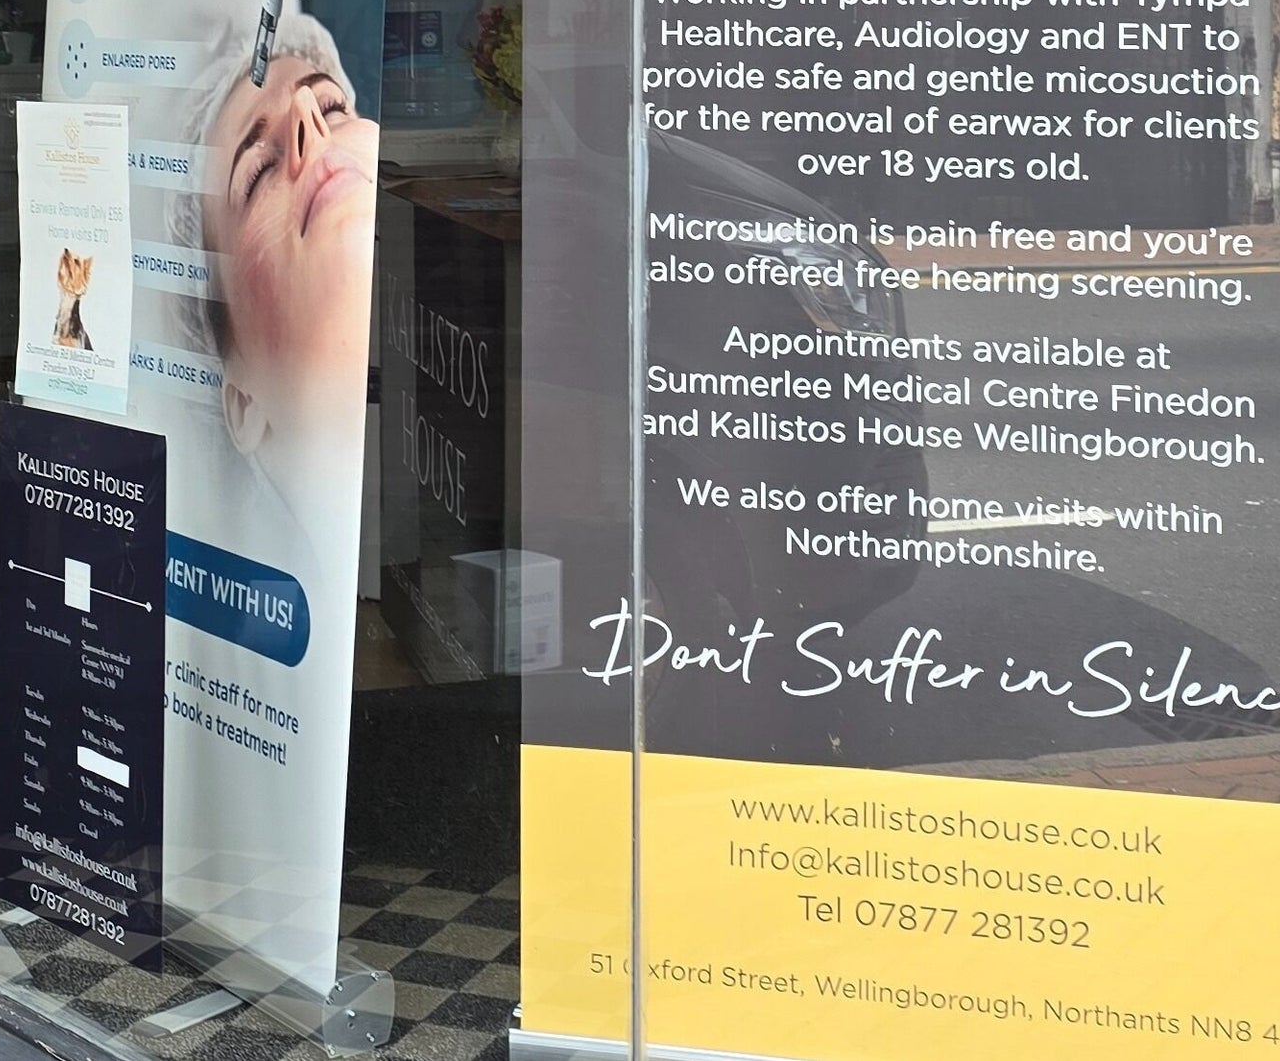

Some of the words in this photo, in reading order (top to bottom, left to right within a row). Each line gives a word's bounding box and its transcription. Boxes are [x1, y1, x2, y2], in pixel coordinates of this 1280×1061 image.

[103, 54, 146, 68] ENLARGED
[148, 56, 176, 70] PORES
[662, 19, 842, 50] Healthcare,
[855, 21, 1029, 54] Audiology
[1041, 22, 1104, 49] and
[1119, 23, 1191, 50] ENT
[1203, 25, 1239, 50] to
[643, 62, 764, 92] provide
[776, 63, 842, 89] safe
[854, 64, 914, 90] and
[927, 65, 1033, 96] gentle
[1047, 66, 1259, 95] micosuction
[646, 103, 688, 129] for
[699, 104, 750, 130] the
[762, 106, 891, 132] removal
[904, 107, 938, 133] of
[949, 114, 1071, 136] earwax
[1084, 110, 1133, 137] for
[1145, 111, 1259, 139] clients
[148, 157, 189, 174] REDNESS
[799, 155, 870, 175] over
[881, 150, 913, 176] 18
[925, 157, 1014, 182] years
[1027, 153, 1088, 180] old.
[651, 213, 857, 244] Microsuction
[871, 218, 894, 245] is
[907, 220, 976, 250] pain
[989, 221, 1055, 249] free
[1067, 225, 1130, 251] and
[1144, 228, 1252, 258] you're
[188, 264, 210, 281] SKIN
[650, 255, 714, 282] also
[726, 255, 843, 286] offered
[855, 260, 919, 289] free
[933, 263, 1058, 299] hearing
[1072, 272, 1251, 305] screening.
[388, 273, 489, 420] KALLISTOS
[724, 327, 961, 360] Appointments
[974, 337, 1124, 367] available
[1137, 343, 1170, 369] at
[167, 361, 197, 383] LOOSE
[200, 370, 223, 388] SKIN
[648, 366, 831, 398] Summerlee
[845, 374, 969, 404] Medical
[984, 380, 1098, 410] Centre
[1112, 385, 1254, 417] Finedon
[402, 390, 467, 527] HOUSE
[644, 409, 697, 436] and
[712, 411, 845, 442] Kallistos
[859, 417, 962, 448] House
[974, 423, 1264, 467] Wellingborough.
[18, 451, 89, 488] KALLISTOS
[94, 469, 144, 503] HOUSE
[25, 483, 135, 532] 07877281392
[678, 478, 729, 506] We
[741, 482, 805, 511] also
[818, 486, 897, 514] offer
[909, 489, 1008, 526] home
[1009, 498, 1107, 527] visits
[1115, 502, 1222, 534] within
[787, 523, 1104, 571] Northamptonshire.
[211, 572, 259, 617] WITH
[263, 594, 293, 630] US!
[782, 622, 986, 706] Suffer
[1000, 659, 1072, 694] in
[176, 665, 206, 692] clinic
[208, 677, 240, 706] staff
[243, 690, 262, 715] for
[265, 703, 299, 734] more
[173, 694, 203, 724] book
[205, 713, 212, 731] a
[216, 717, 287, 766] treatment!
[731, 799, 1161, 859] www.kallistoshouse.co.uk
[731, 836, 1164, 911] Info@kallistoshouse.co.uk
[30, 884, 125, 946] 07877281392
[798, 895, 840, 922] Tel
[856, 900, 957, 933] 07877
[972, 912, 1089, 948] 281392
[590, 955, 614, 975] 51
[723, 967, 805, 993] Street,
[815, 976, 1033, 1018] Wellingborough,
[1045, 1000, 1179, 1033] Northants
[1192, 1016, 1251, 1041] NN8
